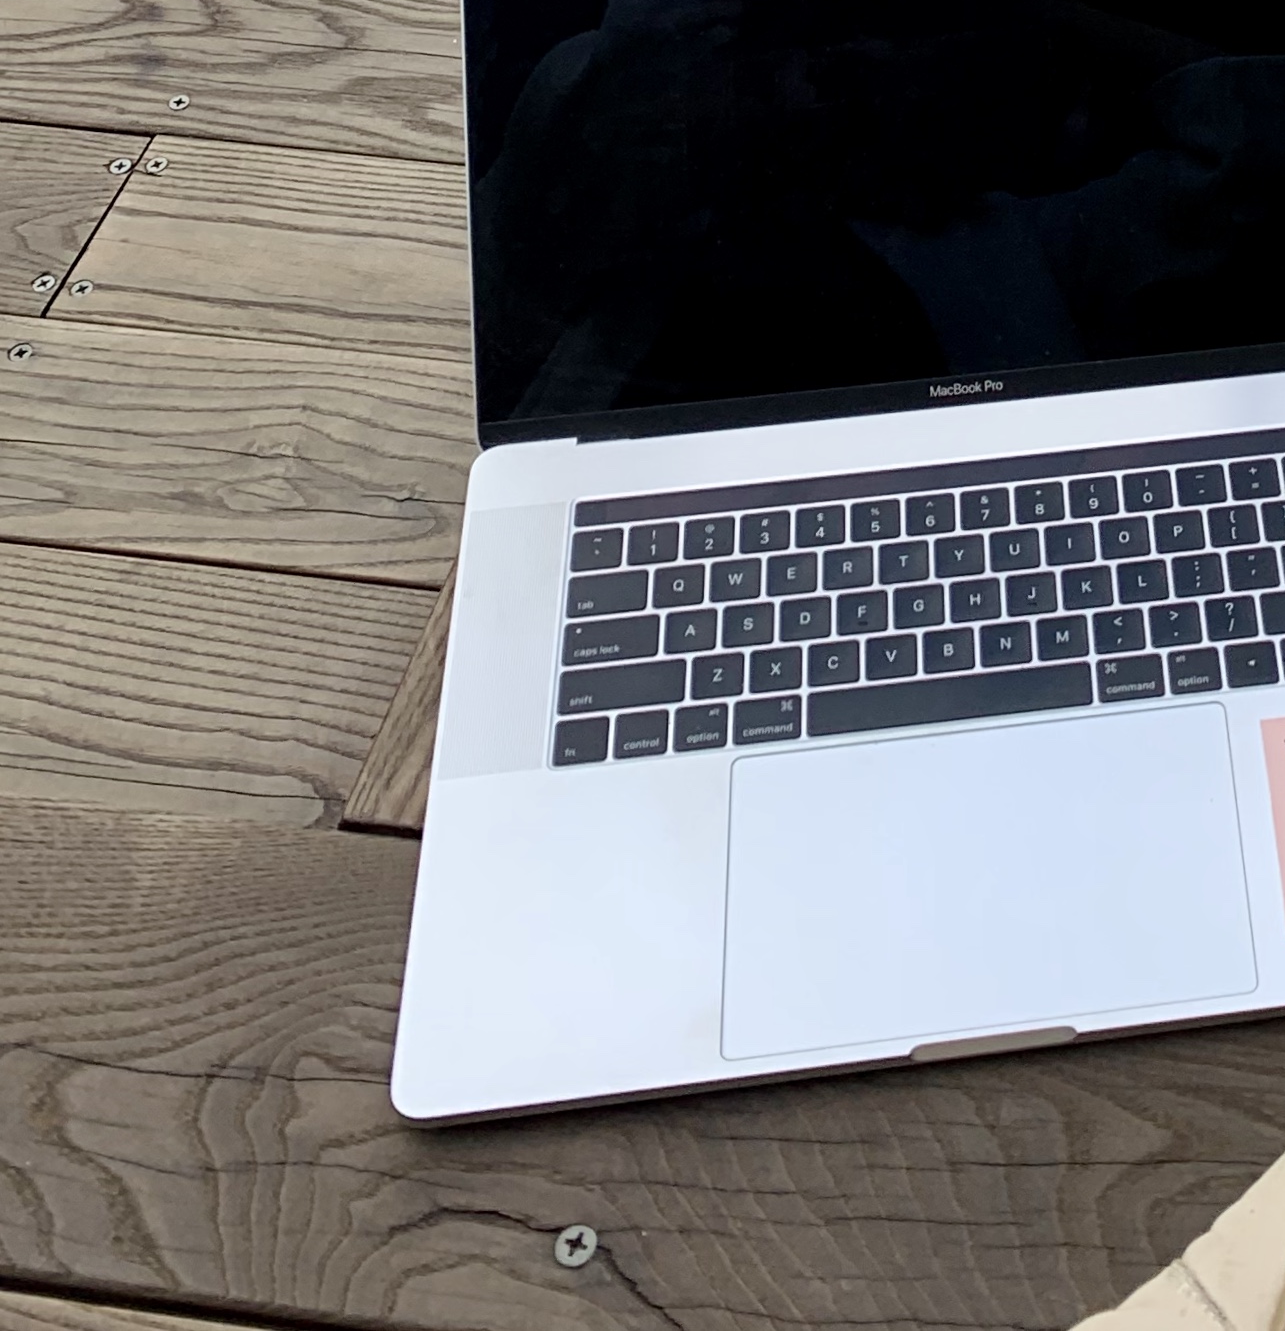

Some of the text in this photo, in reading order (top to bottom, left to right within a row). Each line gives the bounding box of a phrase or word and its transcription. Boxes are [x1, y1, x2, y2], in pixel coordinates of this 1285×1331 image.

[929, 379, 1004, 398] MacBook Pro
[1035, 503, 1045, 515] 8
[1088, 497, 1099, 510] 9
[871, 520, 881, 533] 5
[925, 514, 936, 527] 6
[760, 531, 770, 544] 3
[815, 526, 825, 538] 4
[1173, 525, 1184, 538] P
[704, 538, 714, 551] 2
[1008, 543, 1021, 556] U
[898, 554, 909, 568] T
[954, 549, 964, 561] Y
[786, 566, 796, 580] E
[842, 561, 853, 574] R
[672, 578, 685, 592] Q
[728, 572, 744, 586] W
[1137, 575, 1147, 588] L
[1081, 580, 1092, 594] K
[912, 599, 925, 612] G
[969, 593, 981, 606] H
[857, 605, 867, 618] F
[1224, 602, 1234, 616] ?
[743, 617, 754, 631] S
[799, 611, 811, 625] D
[684, 624, 696, 637] A
[1056, 630, 1070, 644] M
[943, 643, 954, 657] B
[1000, 636, 1012, 650] N
[573, 644, 620, 658] caps lock
[885, 649, 897, 663] V
[770, 662, 781, 676] X
[827, 655, 839, 670] C
[712, 668, 723, 682] Z
[1177, 675, 1210, 687] option
[1105, 680, 1156, 695] command
[569, 695, 593, 707] shift
[742, 722, 794, 738] command
[623, 737, 660, 751] control
[686, 732, 720, 744] option
